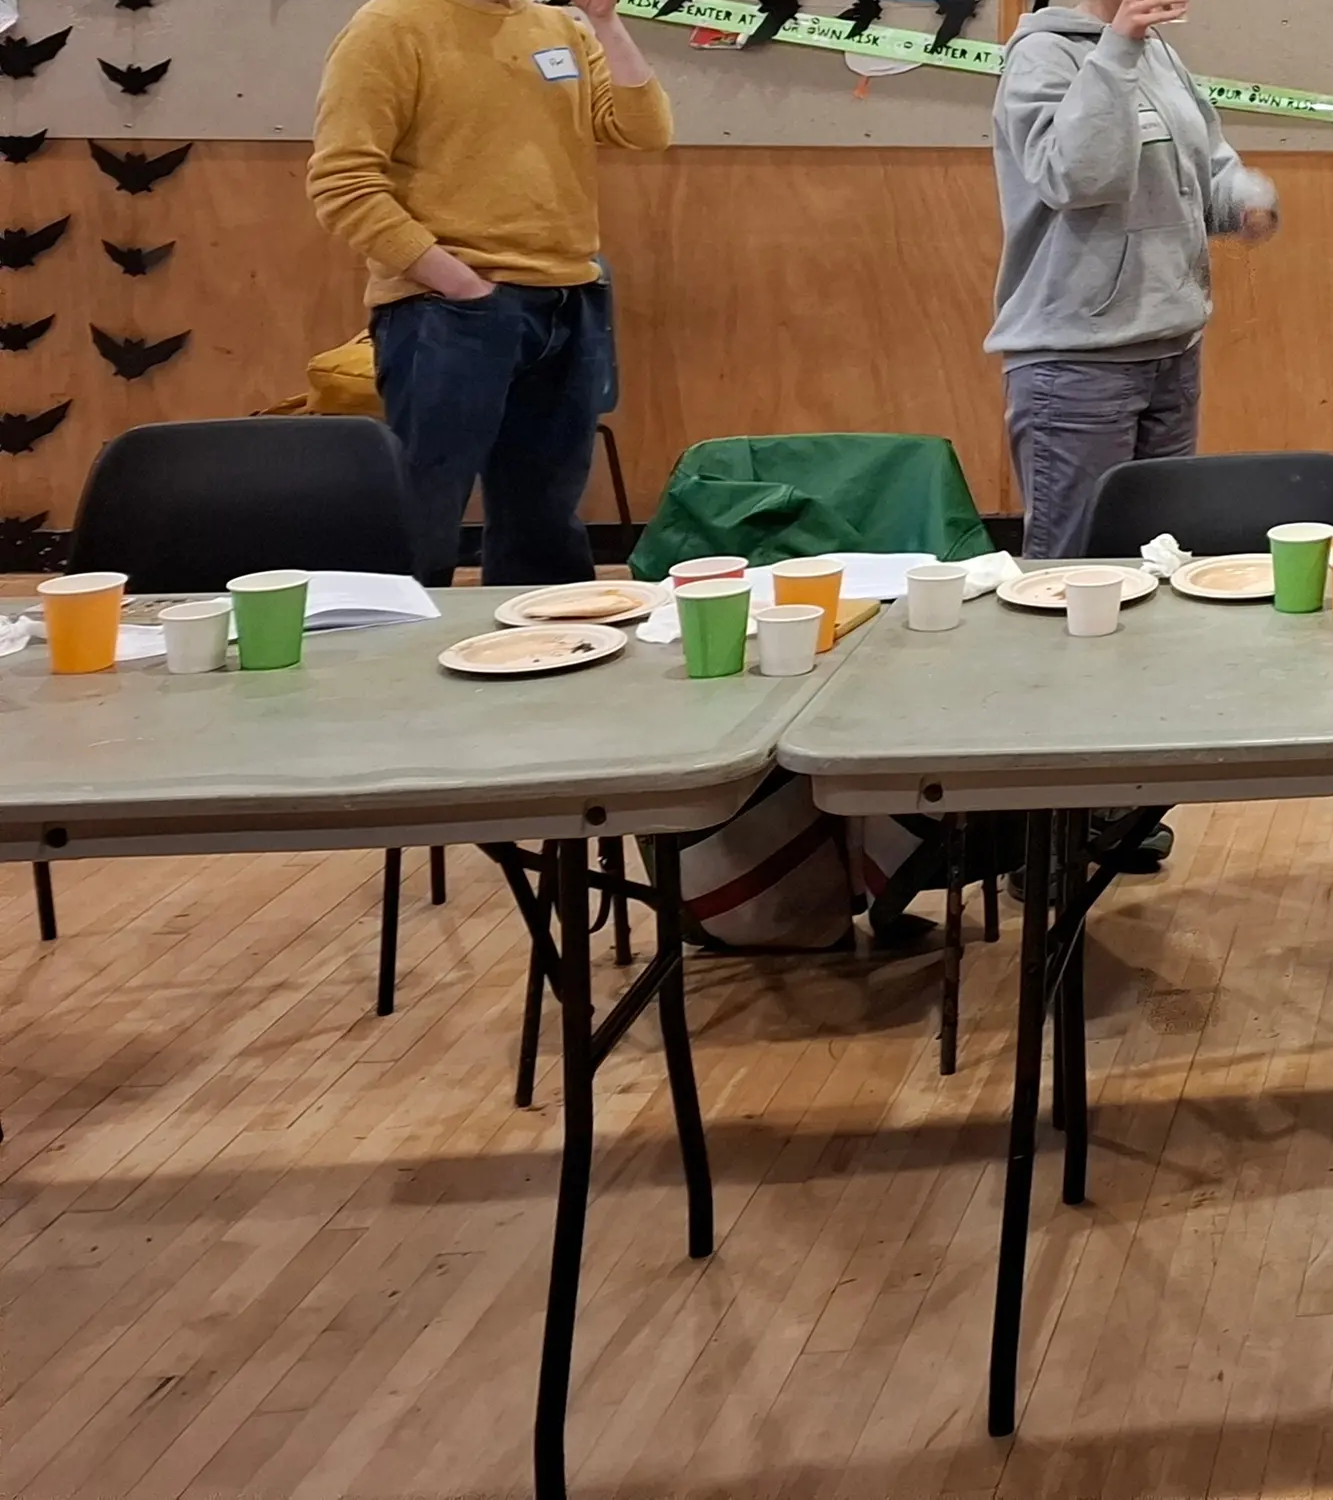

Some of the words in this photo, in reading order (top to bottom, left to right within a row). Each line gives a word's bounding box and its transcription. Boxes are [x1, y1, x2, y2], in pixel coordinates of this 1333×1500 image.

[685, 4, 733, 22] ENTER
[737, 12, 757, 25] AT
[806, 25, 842, 41] OWN
[973, 51, 992, 63] AT
[1208, 85, 1242, 101] YOUR
[1249, 91, 1282, 108] OWN
[1287, 96, 1316, 112] RISK
